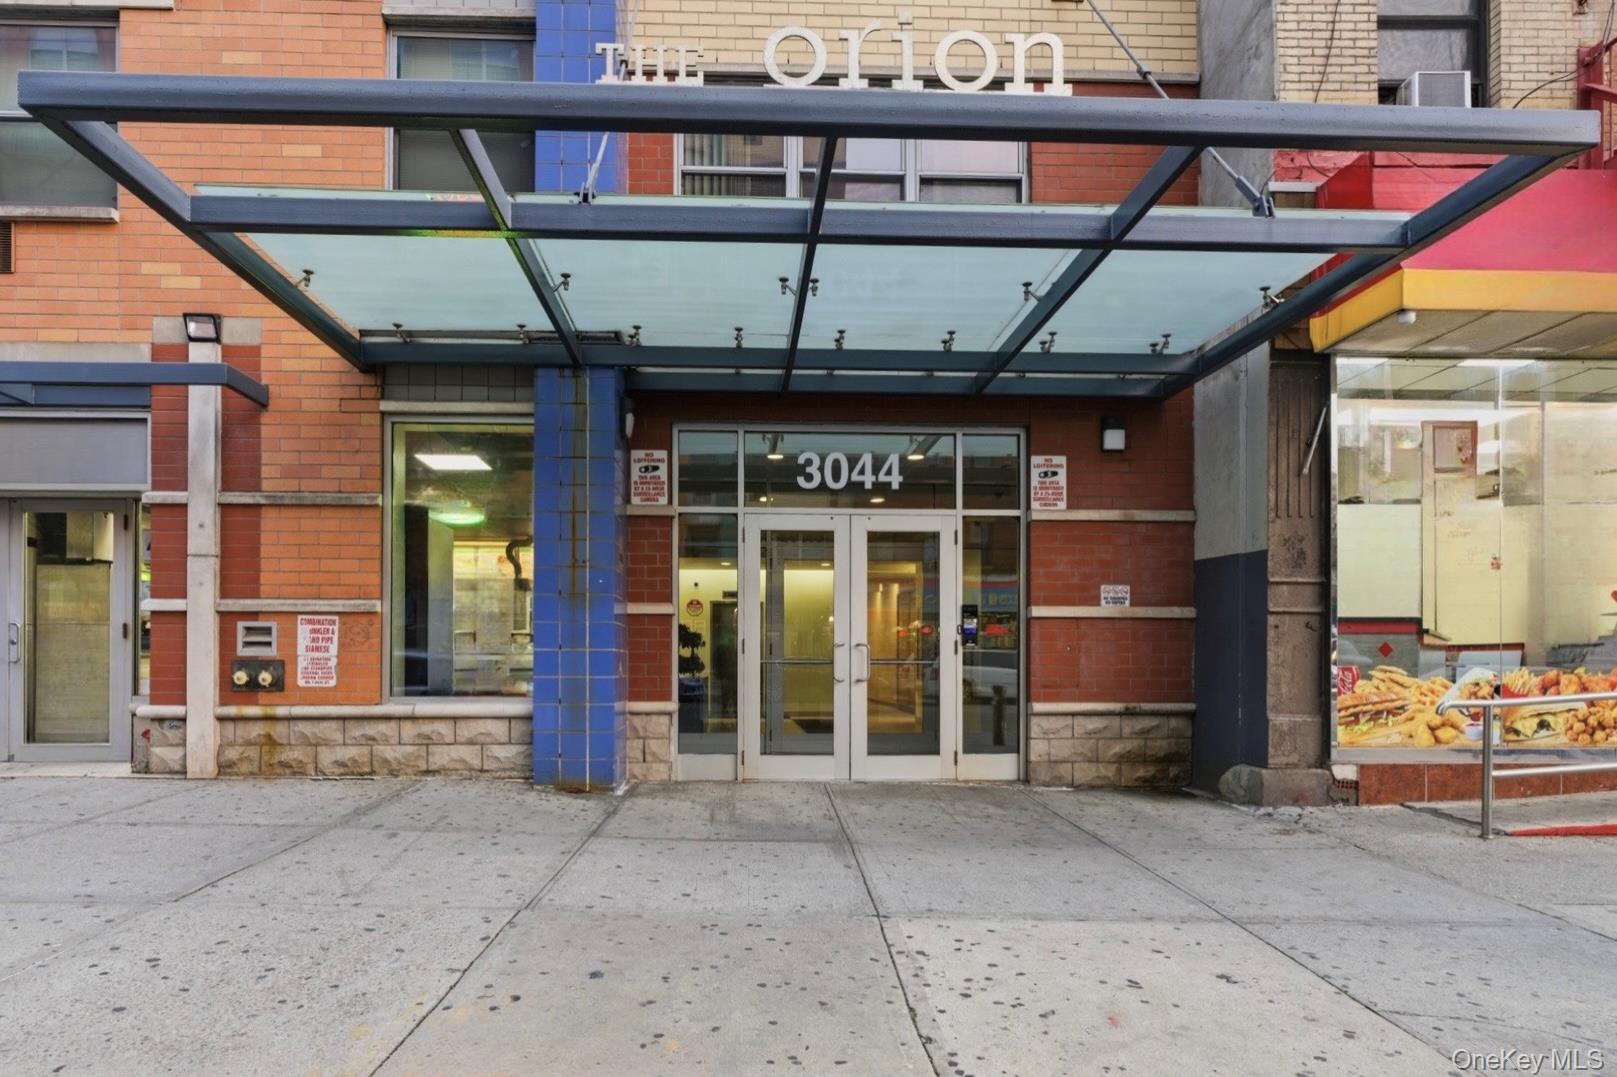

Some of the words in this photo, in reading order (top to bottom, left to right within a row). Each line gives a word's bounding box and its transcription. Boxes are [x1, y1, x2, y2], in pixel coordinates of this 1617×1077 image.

[596, 43, 704, 86] THE
[763, 9, 1073, 96] orion
[797, 452, 903, 490] 3044
[300, 617, 337, 626] COMBINATION
